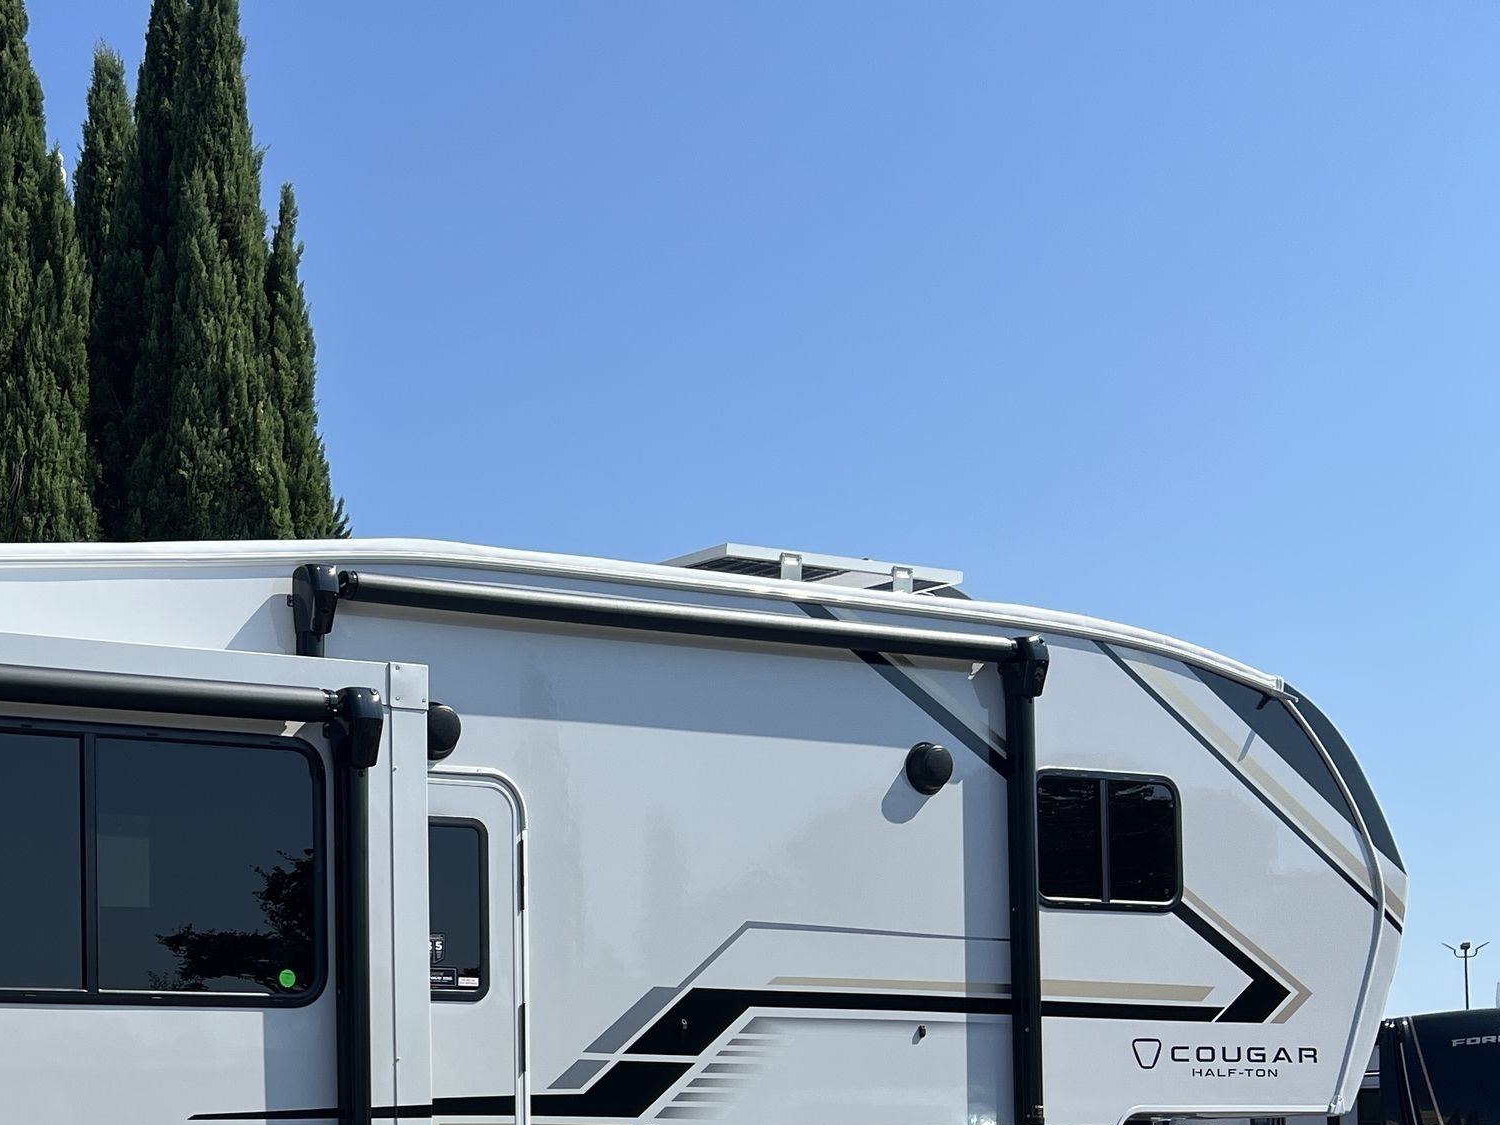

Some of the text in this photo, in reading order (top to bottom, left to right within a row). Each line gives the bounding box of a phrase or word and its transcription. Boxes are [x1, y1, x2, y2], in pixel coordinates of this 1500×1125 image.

[1451, 1035, 1500, 1048] FOR
[1170, 1045, 1318, 1064] COUGAR
[1192, 1068, 1279, 1078] HALF-TON
